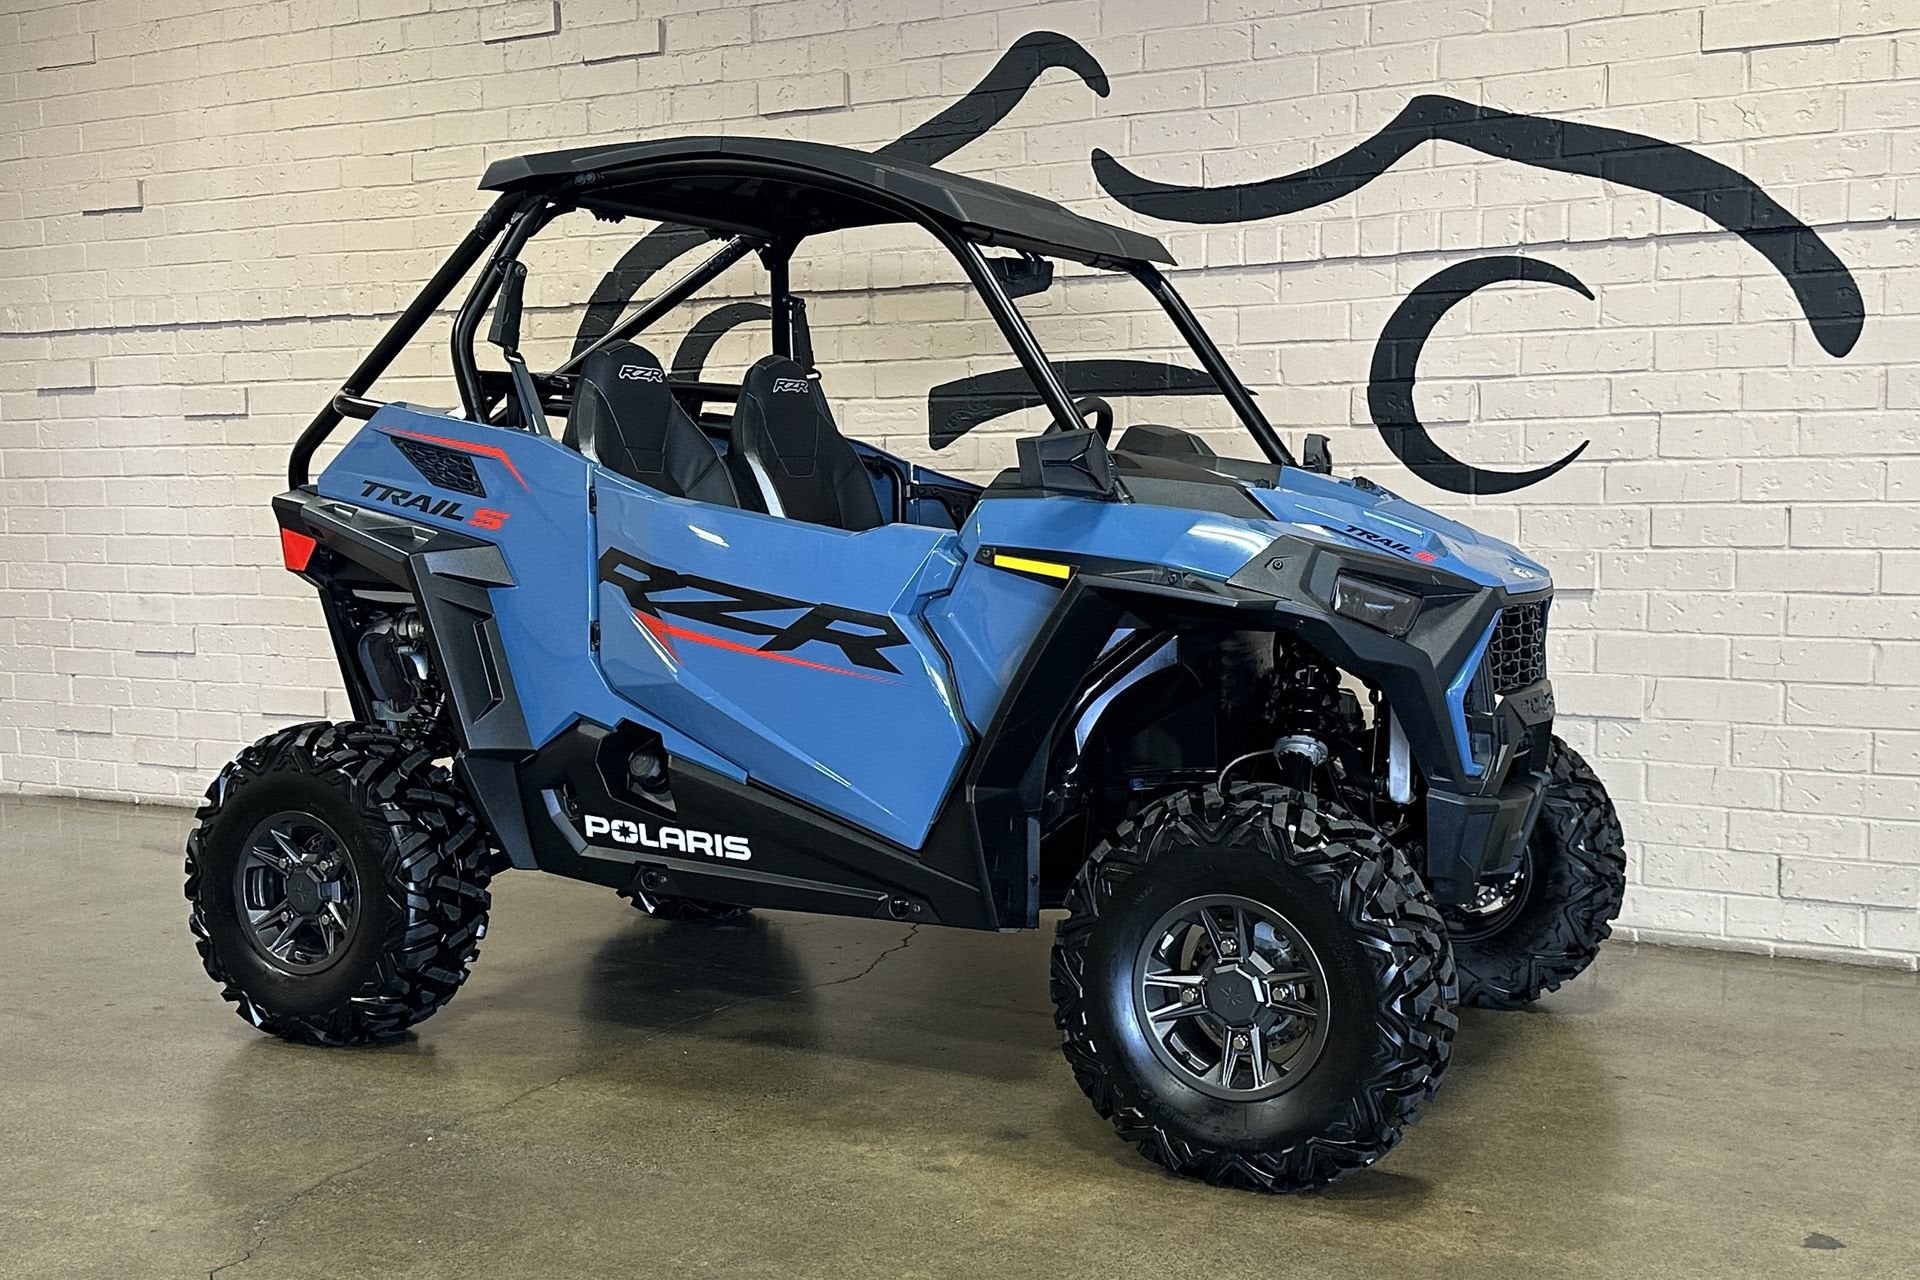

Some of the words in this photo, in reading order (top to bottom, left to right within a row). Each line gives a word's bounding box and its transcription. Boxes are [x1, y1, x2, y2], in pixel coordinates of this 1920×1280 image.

[618, 364, 664, 384] RZR
[772, 377, 809, 394] RZR
[360, 479, 464, 522] TRAIL
[467, 507, 511, 531] S
[1345, 524, 1411, 555] TRAIL
[599, 546, 911, 676] RZR
[584, 814, 752, 862] POLARIS
